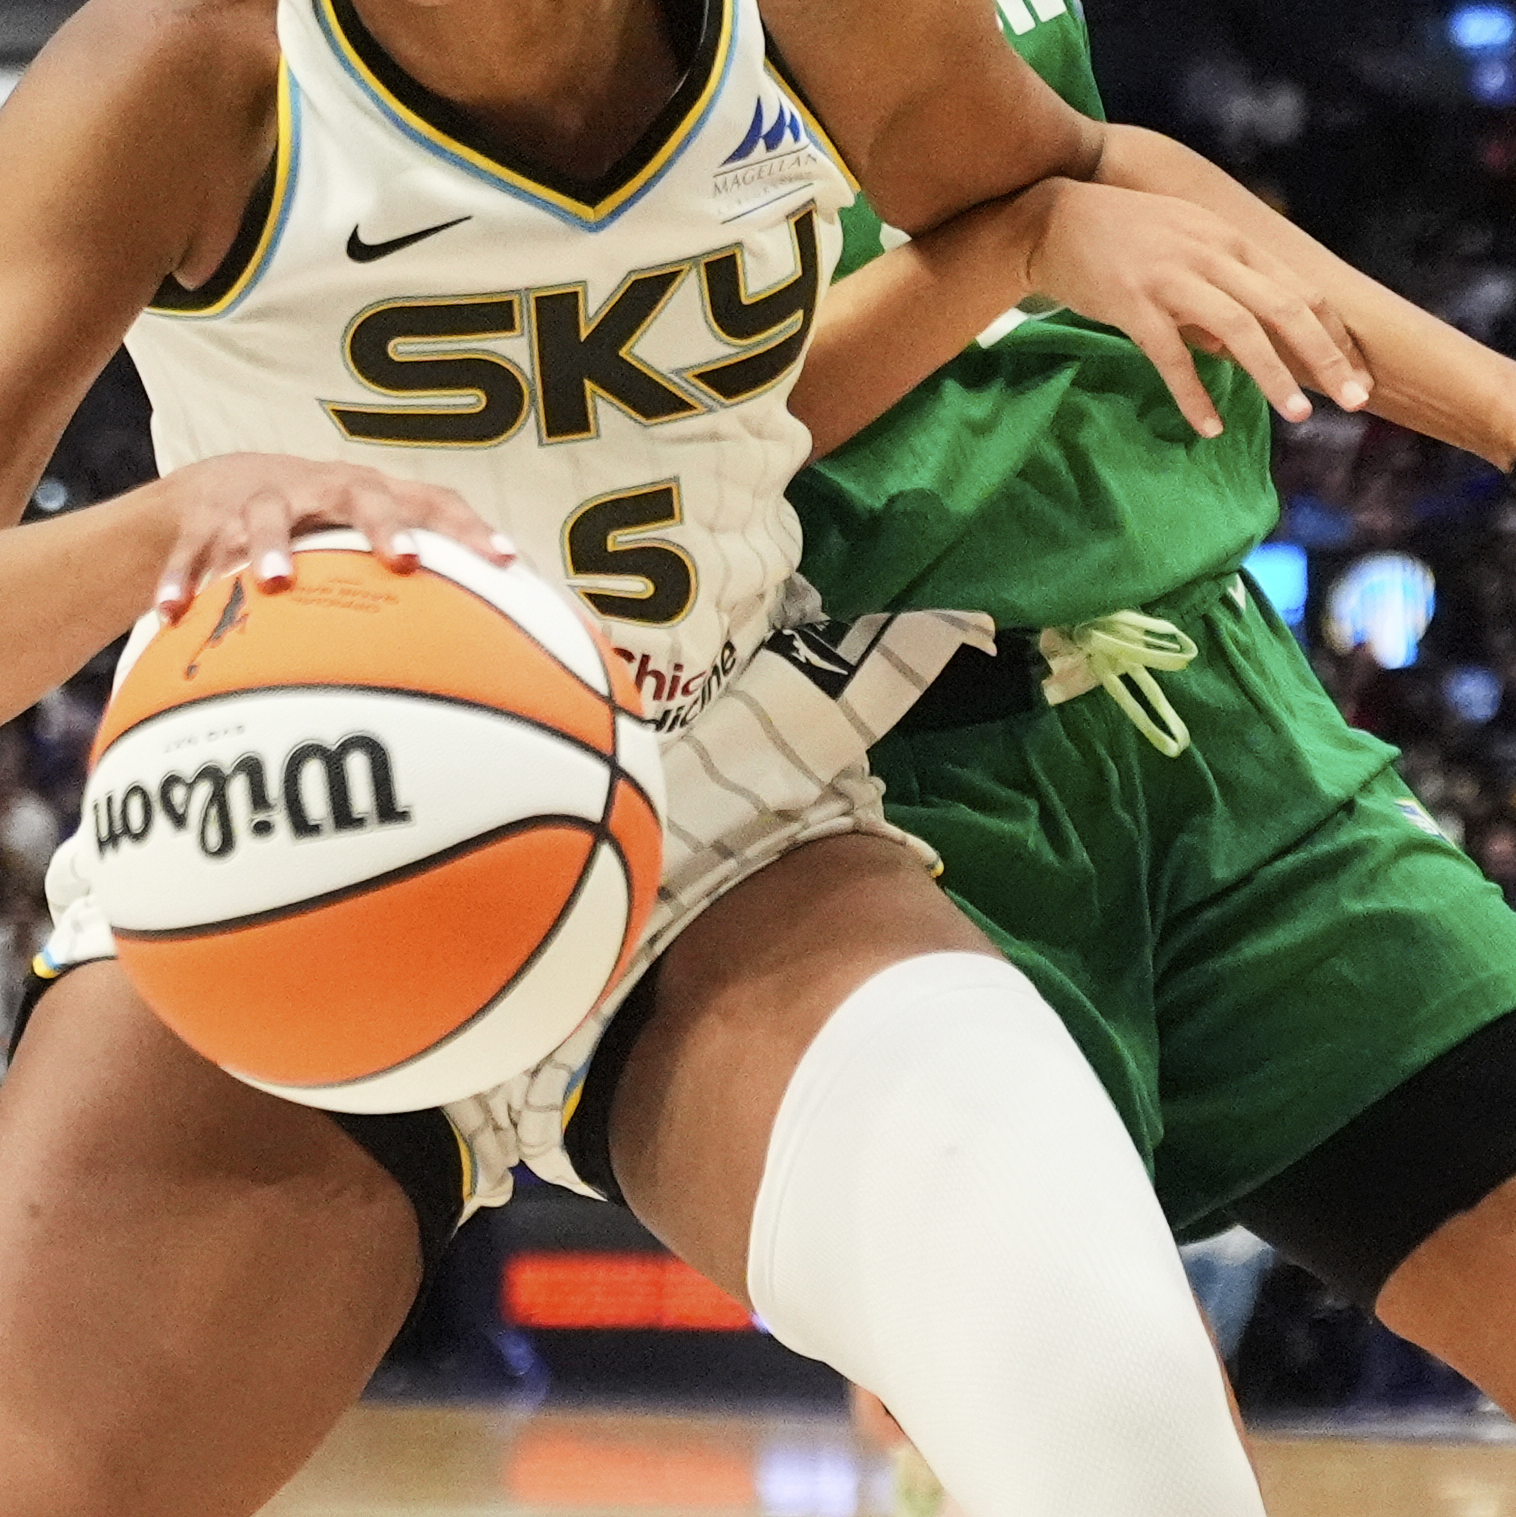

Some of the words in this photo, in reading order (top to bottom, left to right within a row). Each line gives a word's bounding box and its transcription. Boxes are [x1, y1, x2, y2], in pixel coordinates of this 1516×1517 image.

[318, 199, 820, 449] SKY
[559, 476, 699, 628] 5
[92, 732, 413, 860] Wilson
